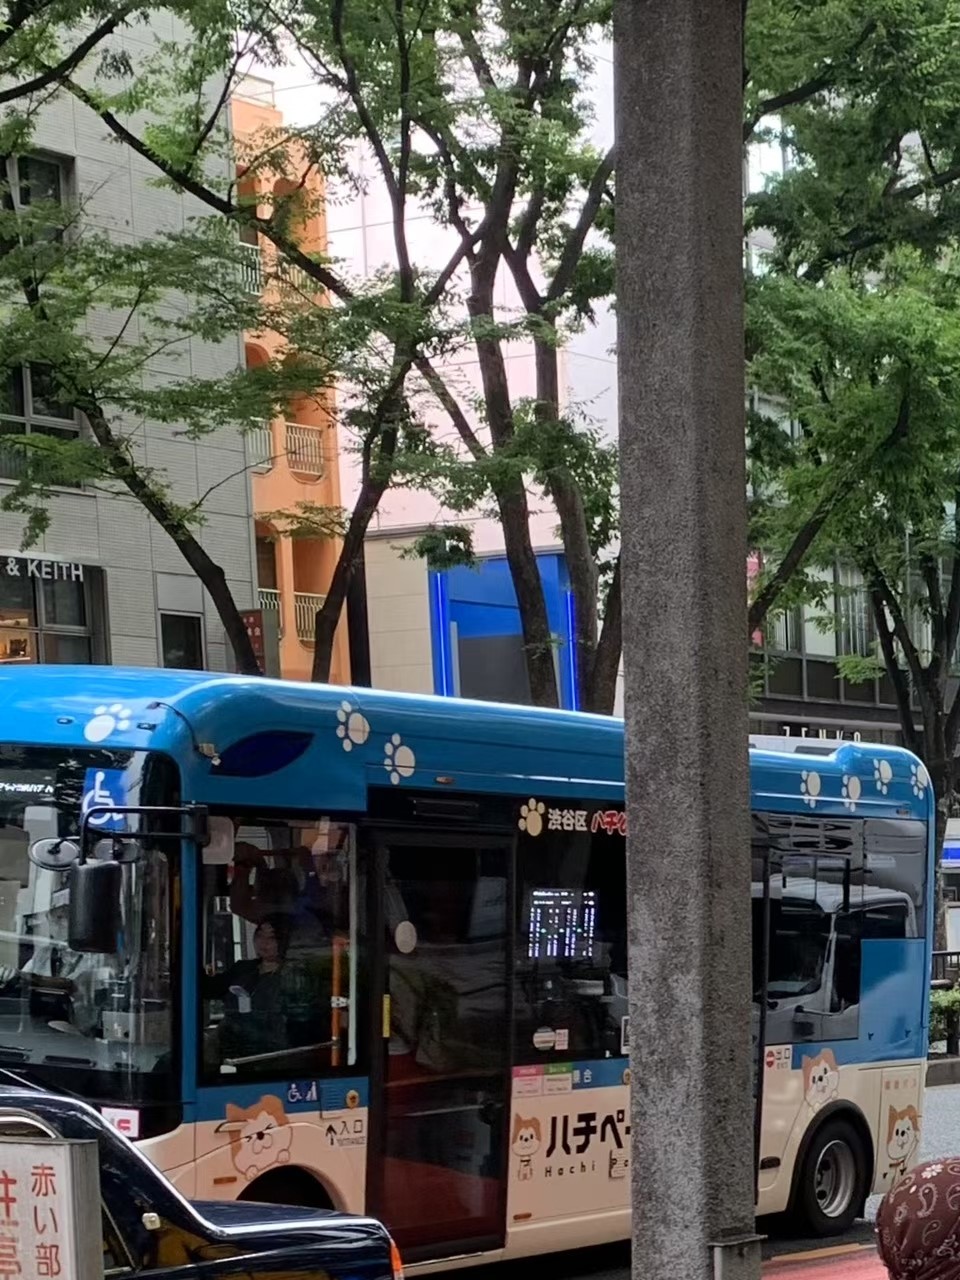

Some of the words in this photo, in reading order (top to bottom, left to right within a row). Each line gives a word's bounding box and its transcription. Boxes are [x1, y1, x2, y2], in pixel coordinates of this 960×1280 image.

[6, 557, 20, 576] &
[27, 559, 84, 582] KEITH
[548, 808, 588, 831] 渋谷区
[340, 1119, 363, 1135] 入口
[546, 1109, 631, 1158] ハチペ
[544, 1160, 596, 1178] Hachi
